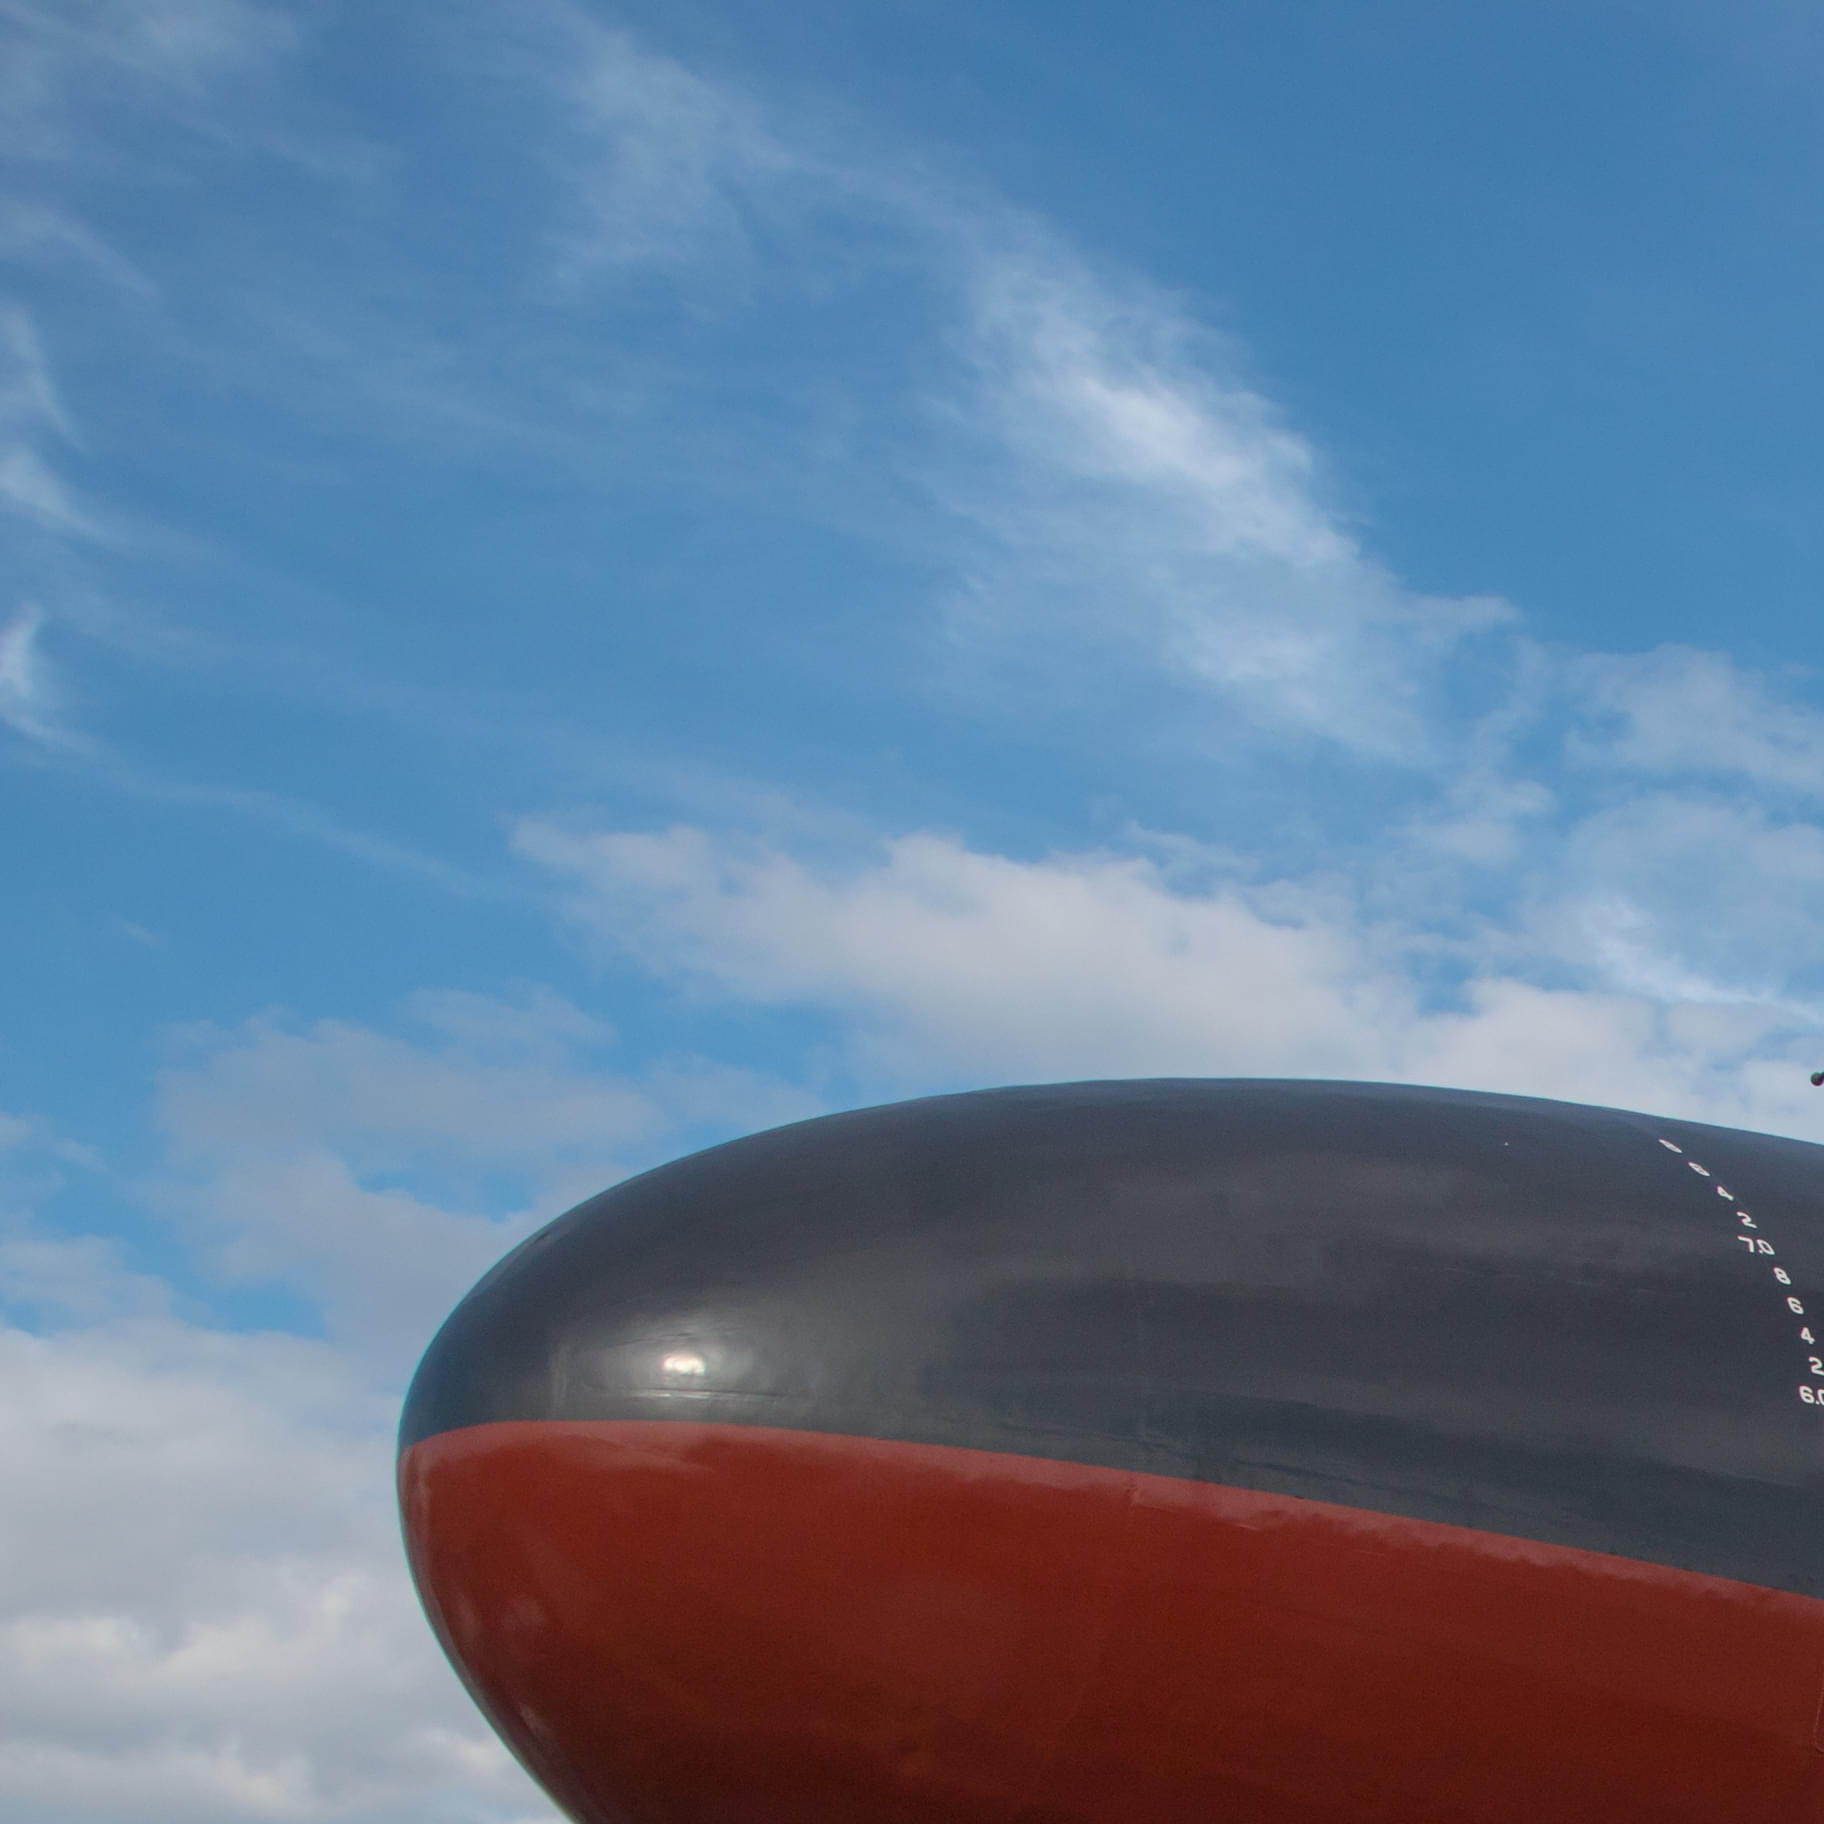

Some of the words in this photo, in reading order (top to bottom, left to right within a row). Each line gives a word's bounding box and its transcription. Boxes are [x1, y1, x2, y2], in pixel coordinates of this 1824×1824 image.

[1737, 1211, 1757, 1228] 2
[1773, 1267, 1791, 1284] 8
[1787, 1297, 1804, 1314] 6
[1801, 1327, 1815, 1344] 4
[1808, 1356, 1824, 1376] 2
